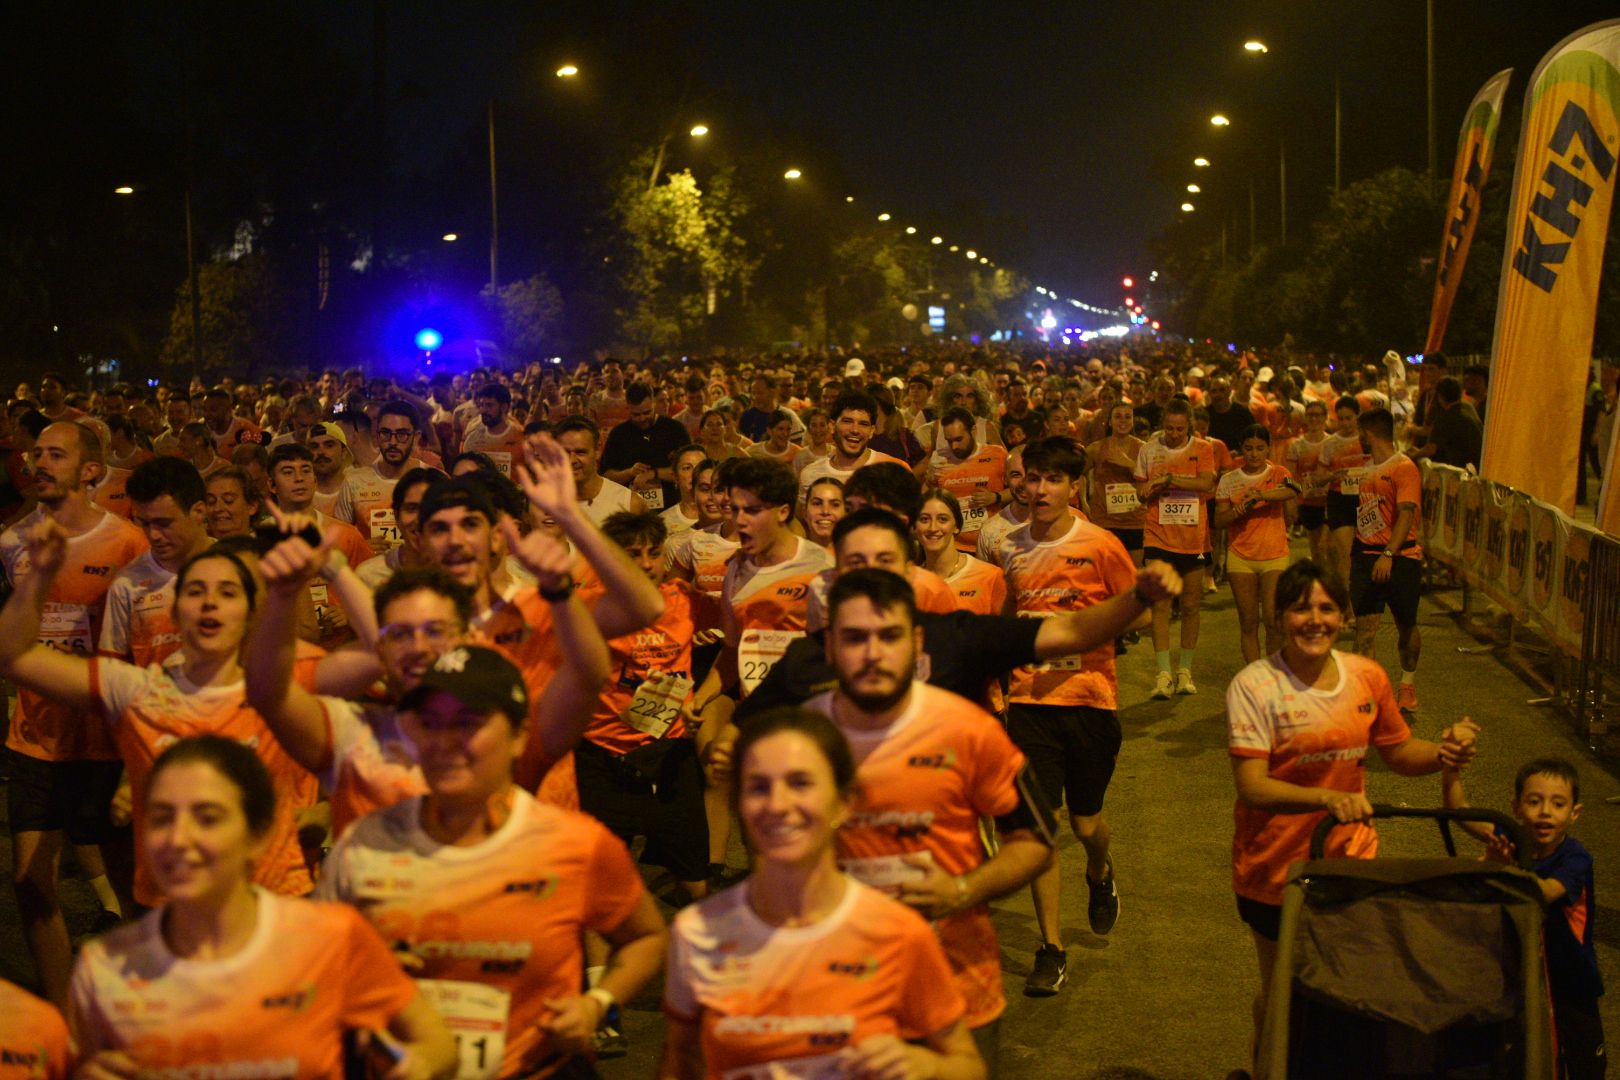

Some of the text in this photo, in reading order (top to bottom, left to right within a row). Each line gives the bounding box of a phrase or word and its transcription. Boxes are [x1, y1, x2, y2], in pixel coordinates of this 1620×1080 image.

[1111, 494, 1135, 504] 3014
[1165, 503, 1192, 514] 3377
[1359, 510, 1377, 528] 3378
[629, 697, 681, 726] 2222
